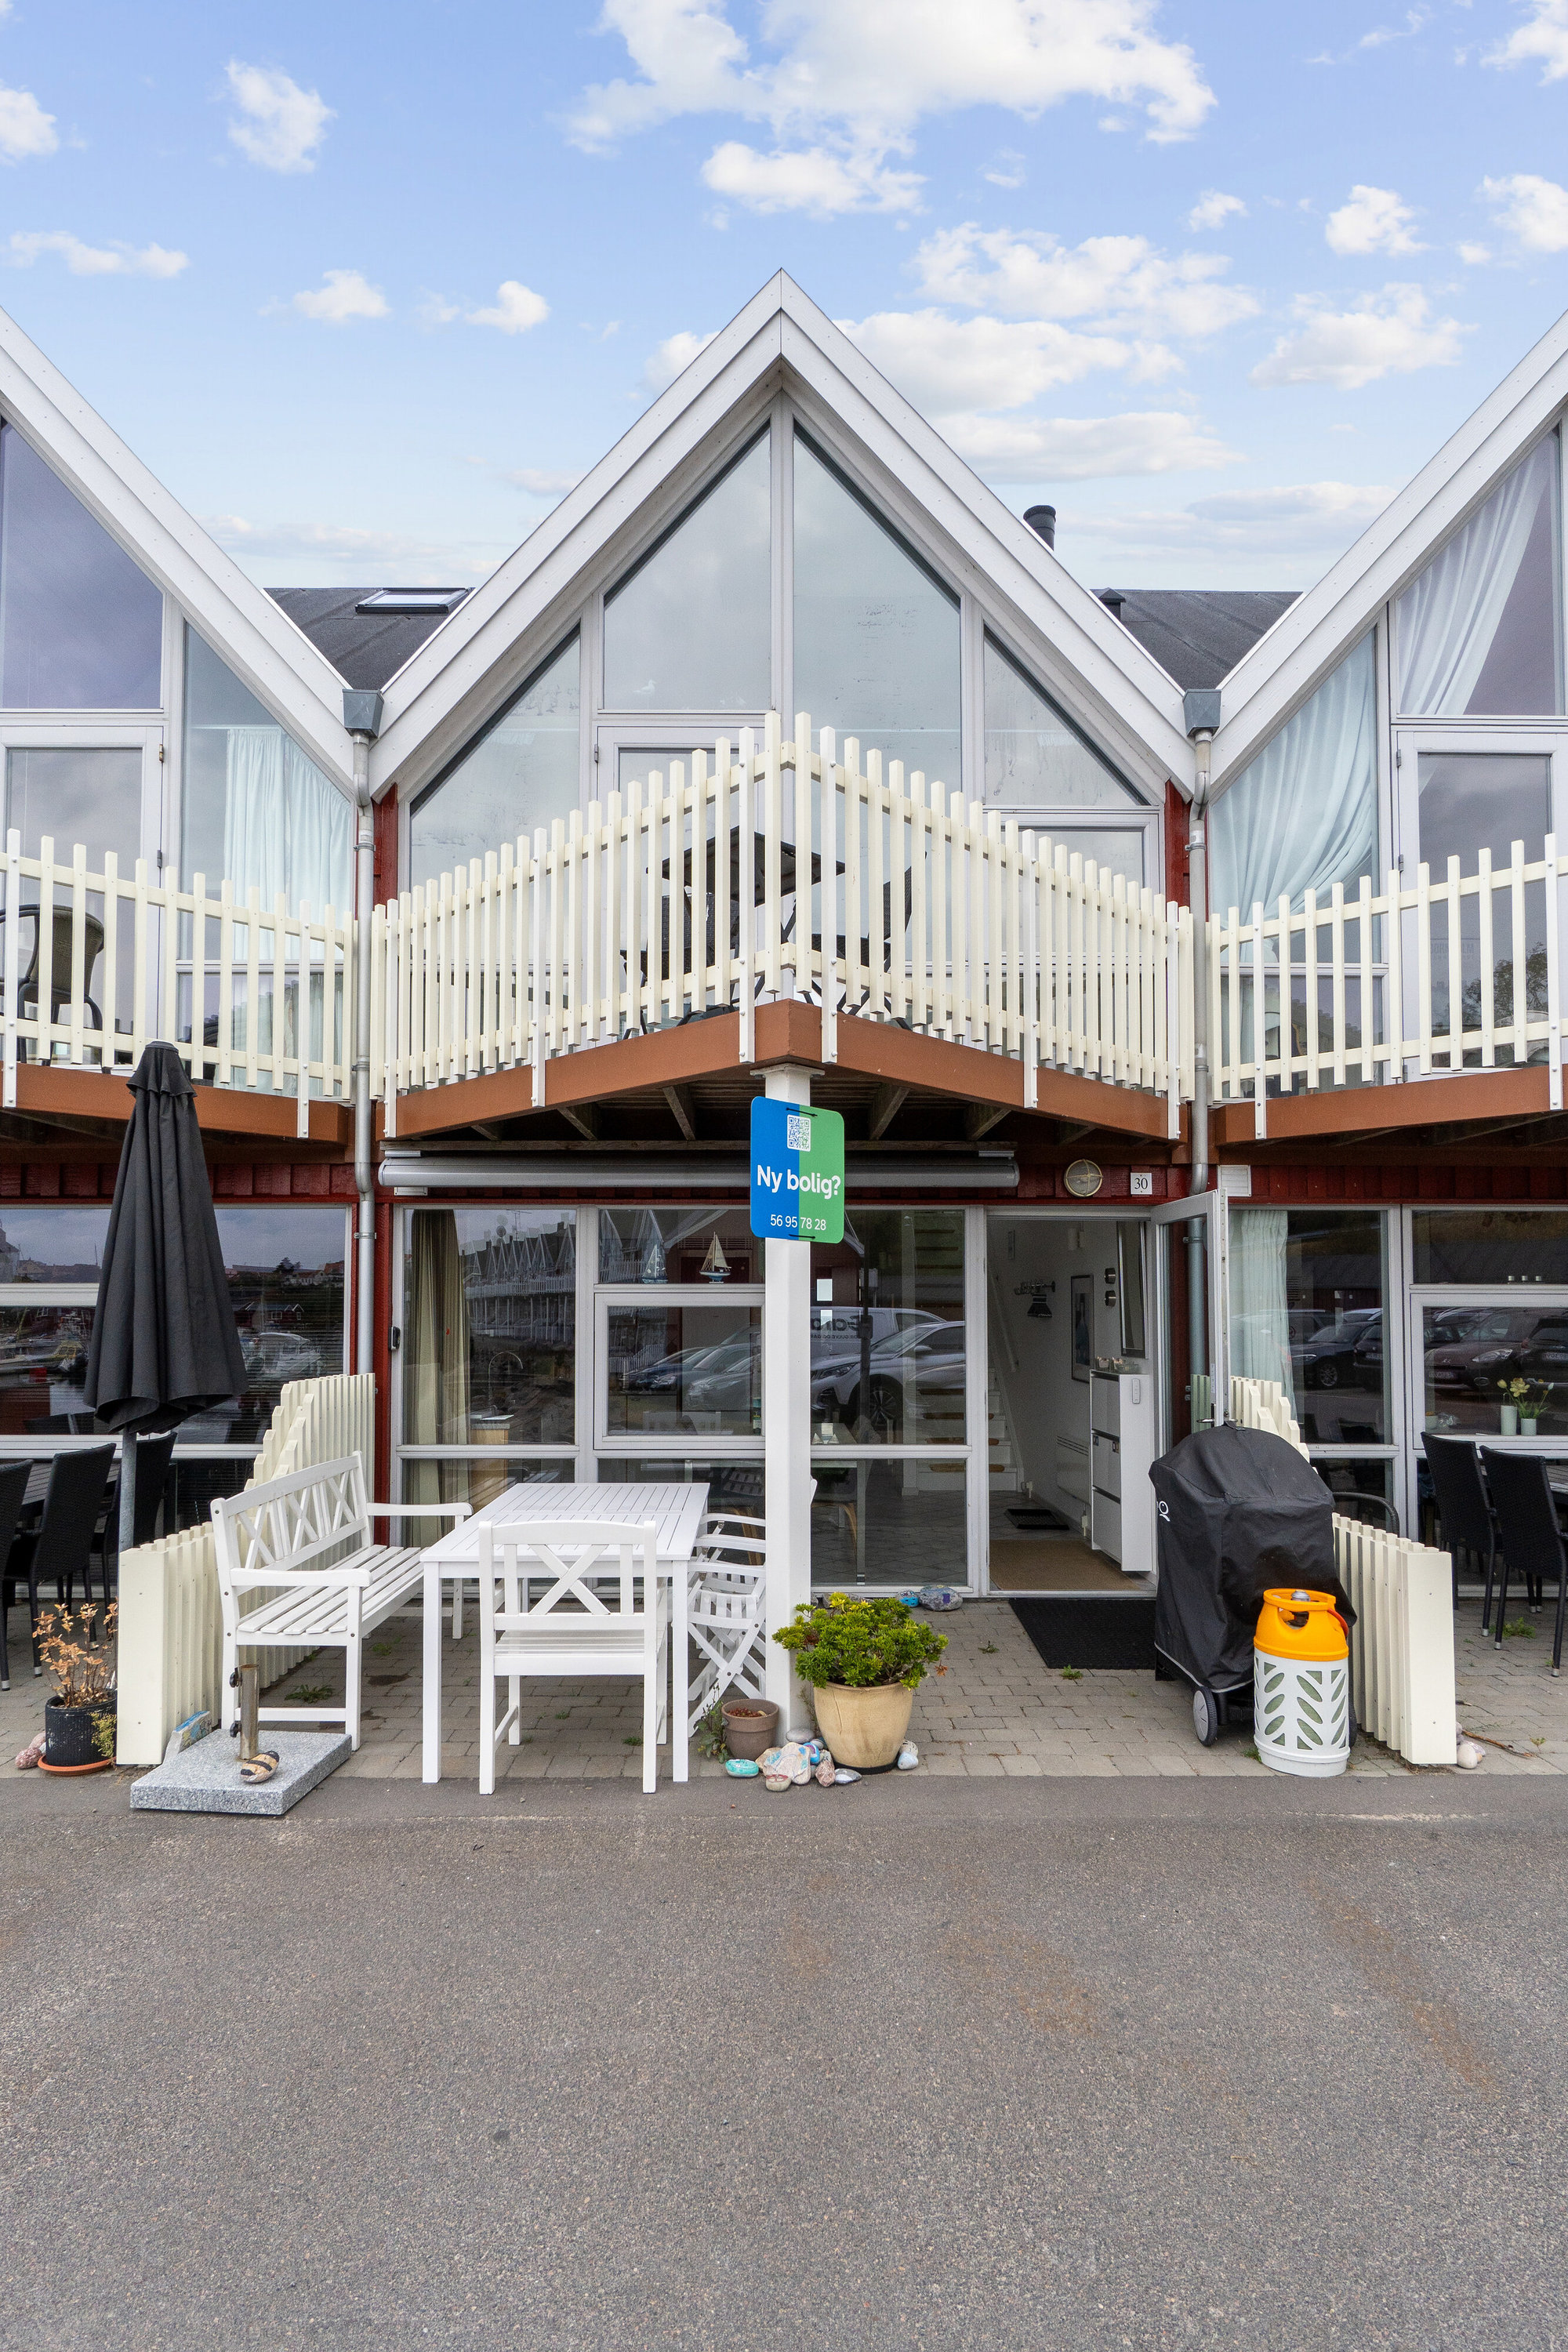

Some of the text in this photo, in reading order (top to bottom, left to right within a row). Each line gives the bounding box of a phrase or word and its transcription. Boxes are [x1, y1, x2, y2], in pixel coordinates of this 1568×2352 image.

[757, 1164, 841, 1200] Ny bolig?
[1134, 1178, 1149, 1189] 30
[770, 1214, 826, 1231] 56 95 78 28
